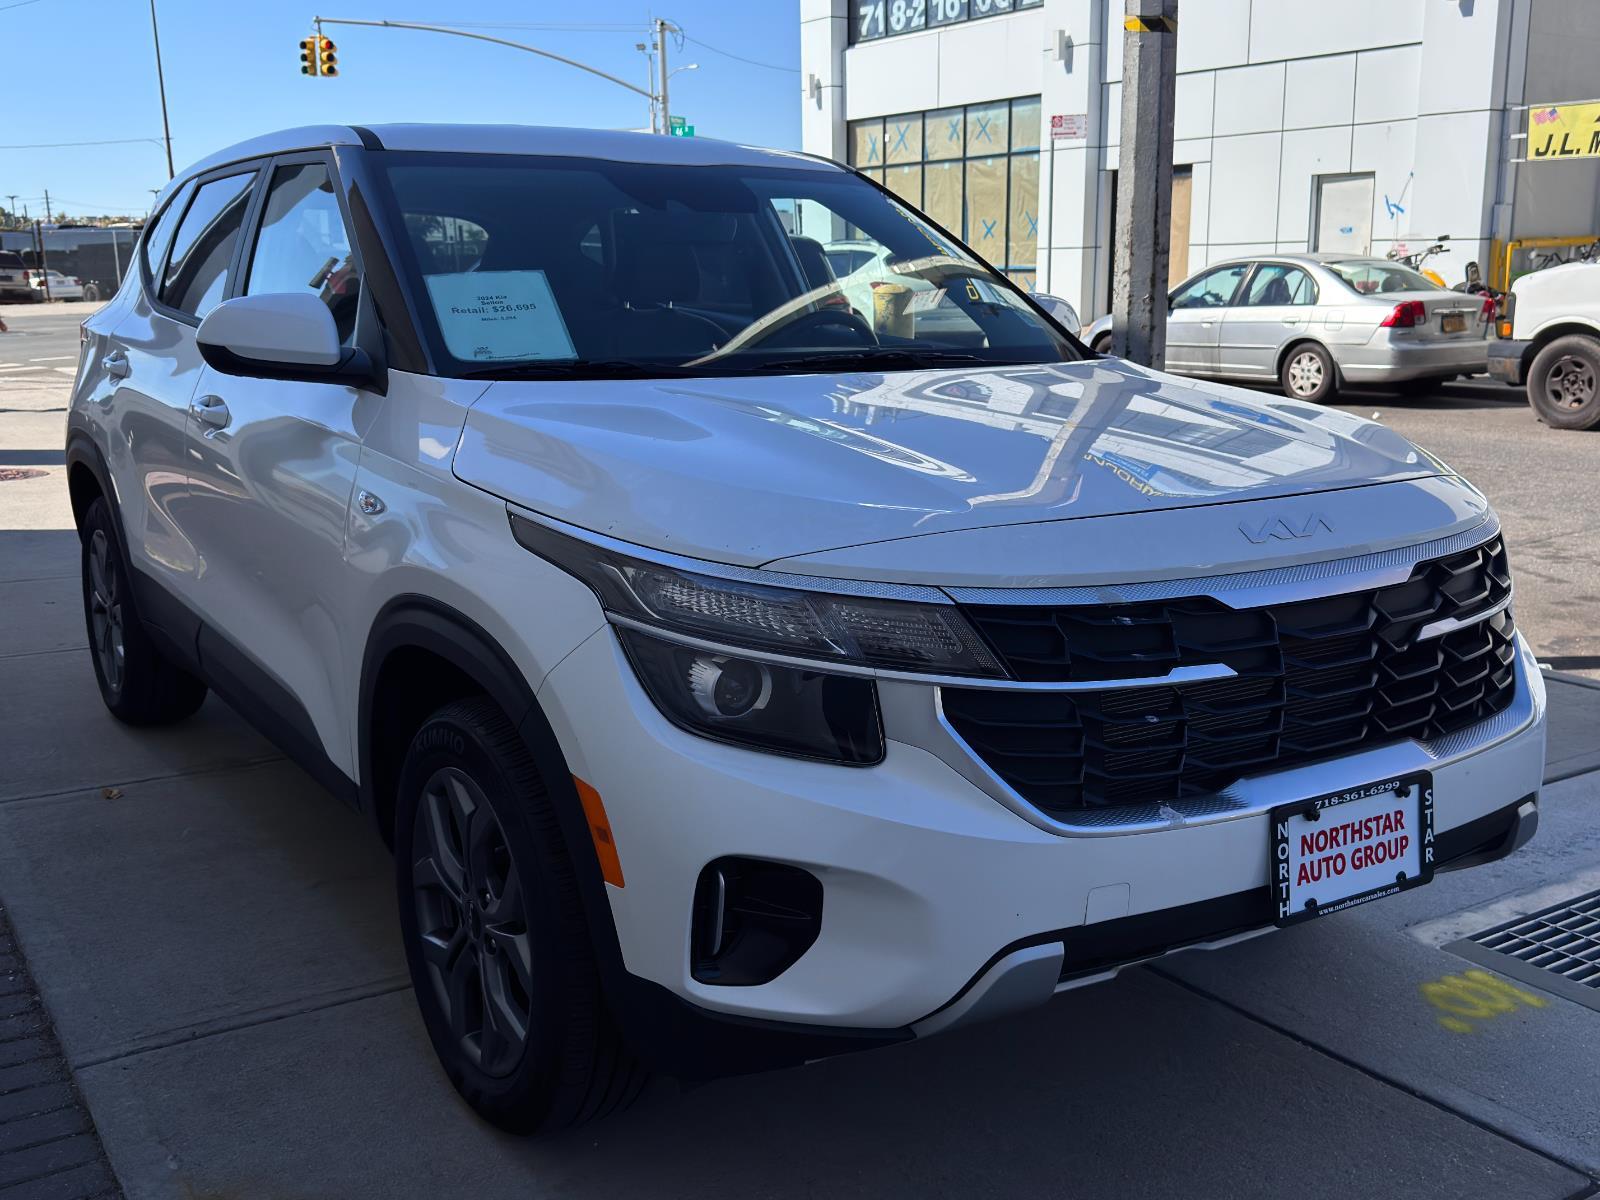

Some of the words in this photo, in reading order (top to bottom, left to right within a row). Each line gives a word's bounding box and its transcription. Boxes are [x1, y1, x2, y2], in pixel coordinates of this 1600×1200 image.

[451, 306, 489, 314] Retail:
[492, 303, 537, 313] $26,695
[416, 727, 465, 755] KUMHO
[1314, 781, 1401, 810] 718-361-6299
[1300, 809, 1405, 857] NORTHSTAR
[1424, 789, 1434, 863] STAR
[1277, 821, 1290, 918] NORTH
[1297, 852, 1347, 886] AUTO
[1350, 835, 1409, 870] GROUP
[1318, 886, 1401, 916] www.northstarcarsales.com
